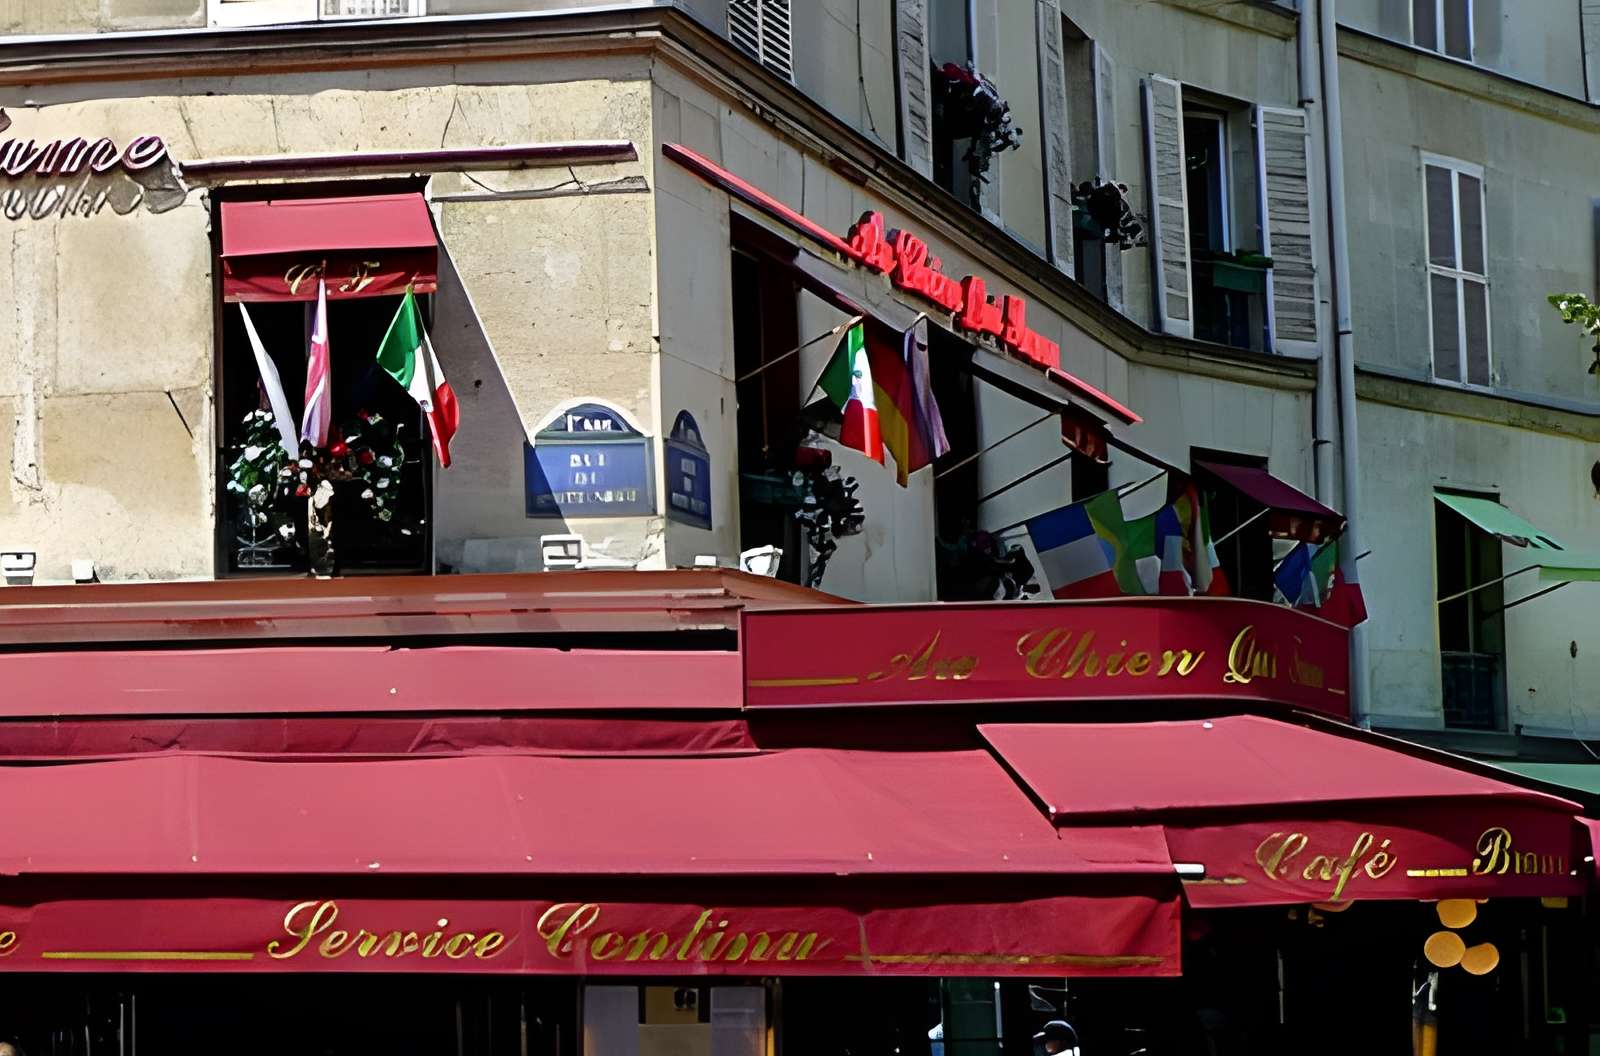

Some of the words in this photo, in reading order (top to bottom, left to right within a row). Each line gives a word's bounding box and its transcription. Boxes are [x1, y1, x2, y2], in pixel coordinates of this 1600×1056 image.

[1016, 626, 1205, 681] Chien
[1255, 831, 1398, 902] Café
[266, 900, 508, 961] Service
[536, 902, 828, 963] Continu
